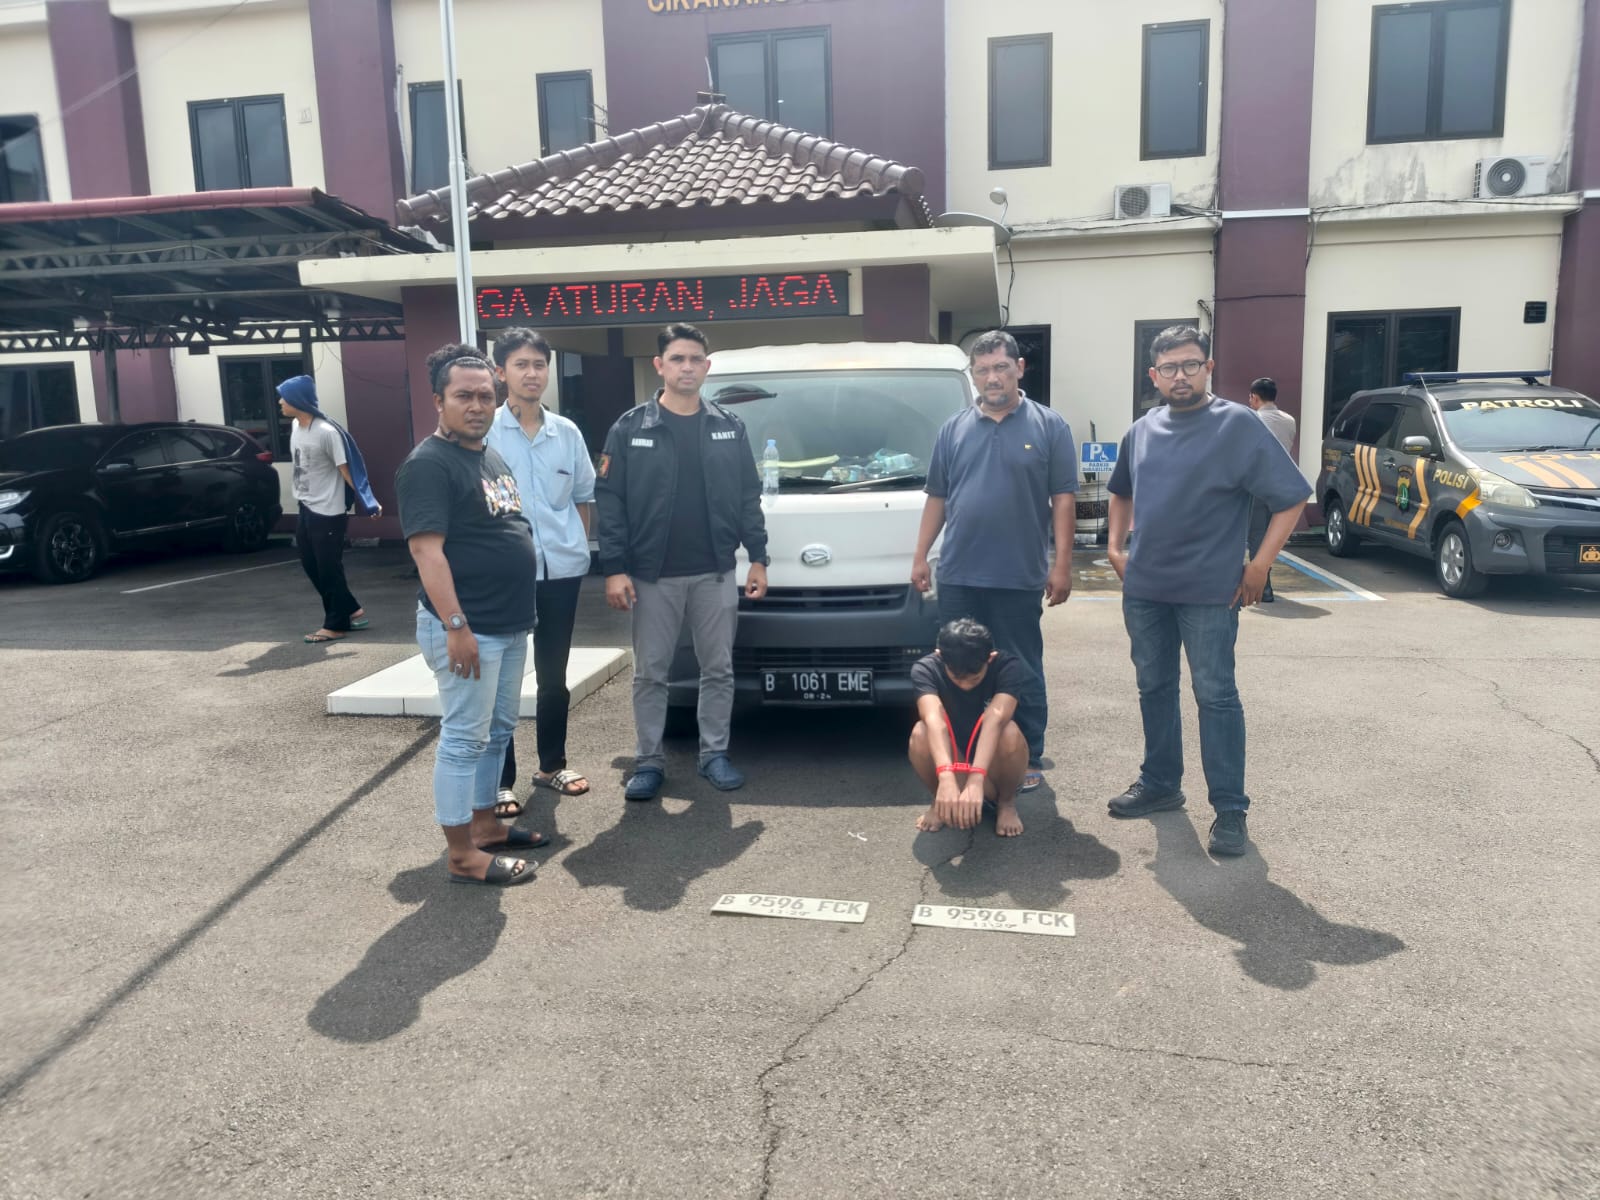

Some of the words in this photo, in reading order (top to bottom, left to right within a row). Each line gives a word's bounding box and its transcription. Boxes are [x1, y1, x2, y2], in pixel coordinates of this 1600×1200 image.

[477, 288, 533, 319] GA
[728, 273, 838, 309] JAGA
[1460, 399, 1583, 411] PATROLI
[1090, 443, 1102, 461] P
[1432, 469, 1469, 489] POLISI
[765, 673, 775, 692] B
[792, 672, 827, 691] 1061
[838, 672, 869, 691] EME
[719, 895, 736, 905] B
[748, 895, 805, 910] 9596
[817, 900, 863, 915] FCK
[918, 906, 933, 918] B
[947, 908, 1007, 923] 9596
[1022, 911, 1069, 928] FCK
